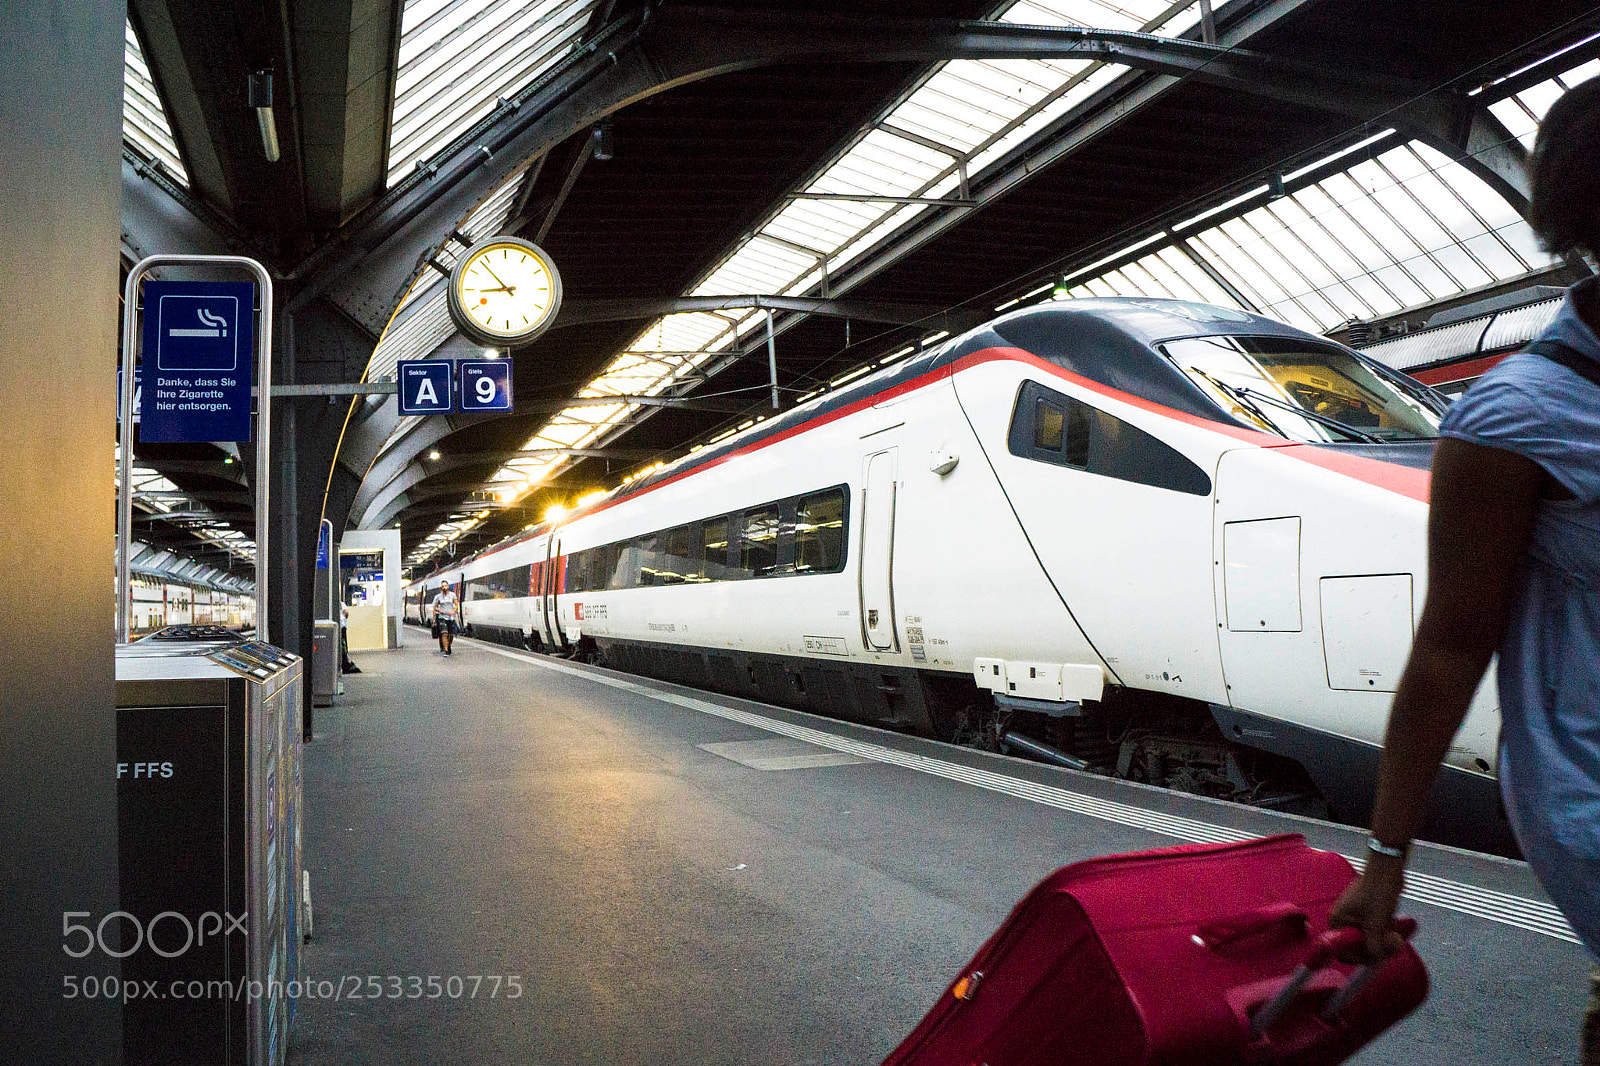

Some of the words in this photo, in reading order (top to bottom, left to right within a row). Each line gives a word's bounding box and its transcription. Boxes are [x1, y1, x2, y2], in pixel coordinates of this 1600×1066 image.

[157, 377, 192, 388] Danke,
[194, 377, 219, 387] dass
[220, 377, 237, 387] Sie
[156, 389, 177, 399] Ihre
[178, 389, 225, 400] Zigarette
[415, 378, 438, 404] A
[475, 377, 495, 403] 9
[156, 401, 177, 410] hier
[178, 402, 232, 412] entsorgen.
[134, 762, 174, 779] FFS
